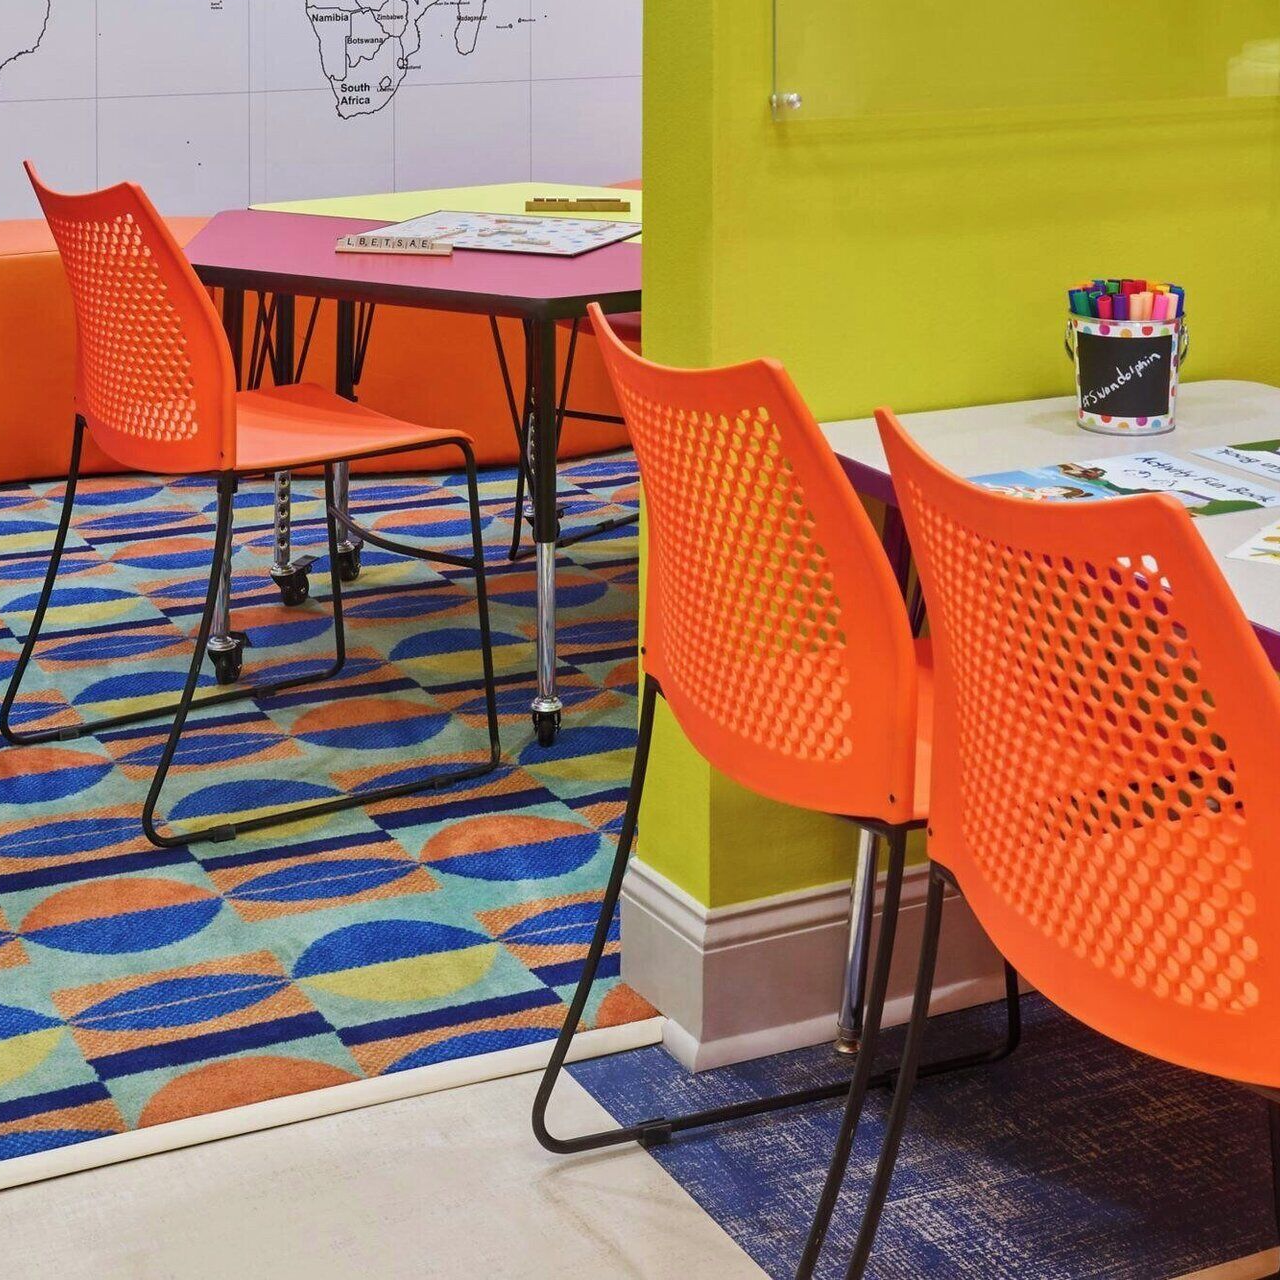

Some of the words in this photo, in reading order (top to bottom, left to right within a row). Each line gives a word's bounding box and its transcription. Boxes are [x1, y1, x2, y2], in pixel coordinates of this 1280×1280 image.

[312, 14, 349, 22] Namibia
[340, 83, 370, 92] South
[340, 96, 370, 105] Africa
[1197, 476, 1227, 489] Fun
[1226, 486, 1274, 503] Book
